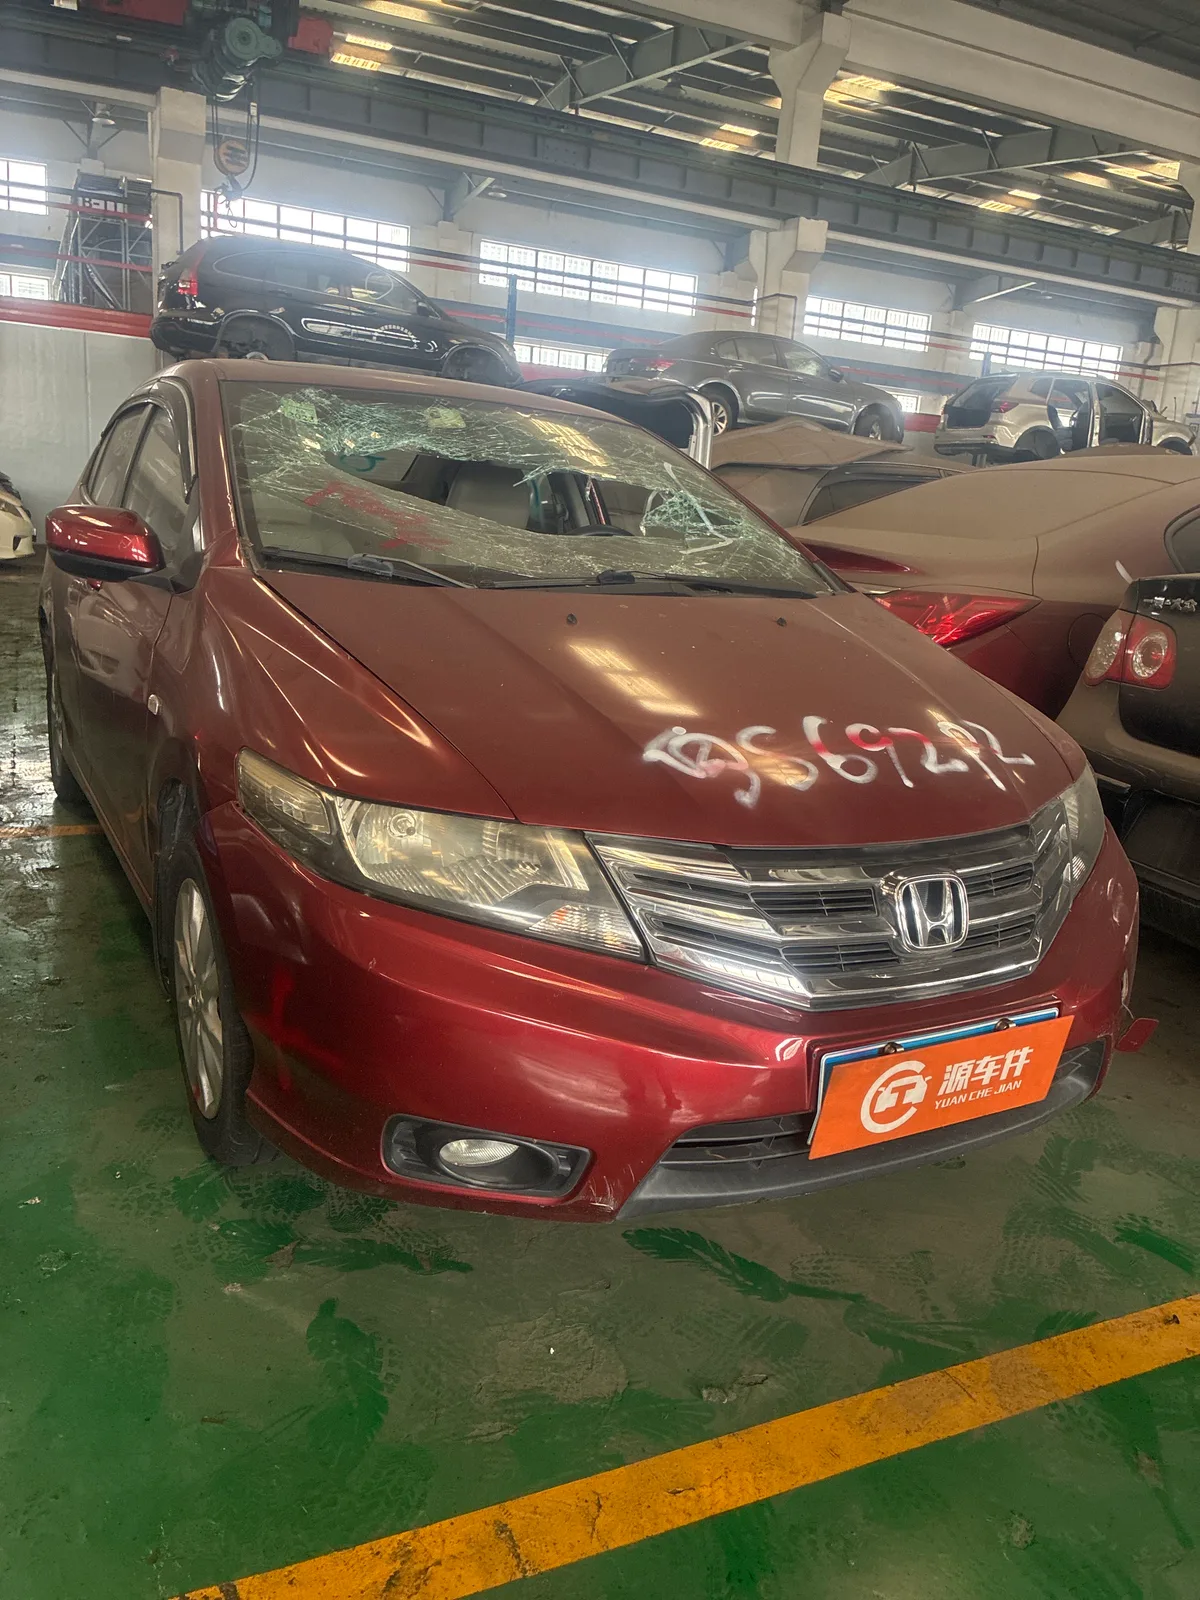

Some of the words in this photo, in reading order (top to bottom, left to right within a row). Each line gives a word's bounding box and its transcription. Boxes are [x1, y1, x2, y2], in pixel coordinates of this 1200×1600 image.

[937, 1046, 1034, 1096] 源车件
[934, 1094, 967, 1109] YUAN
[968, 1087, 993, 1101] CHE
[994, 1080, 1022, 1095] JIAN
